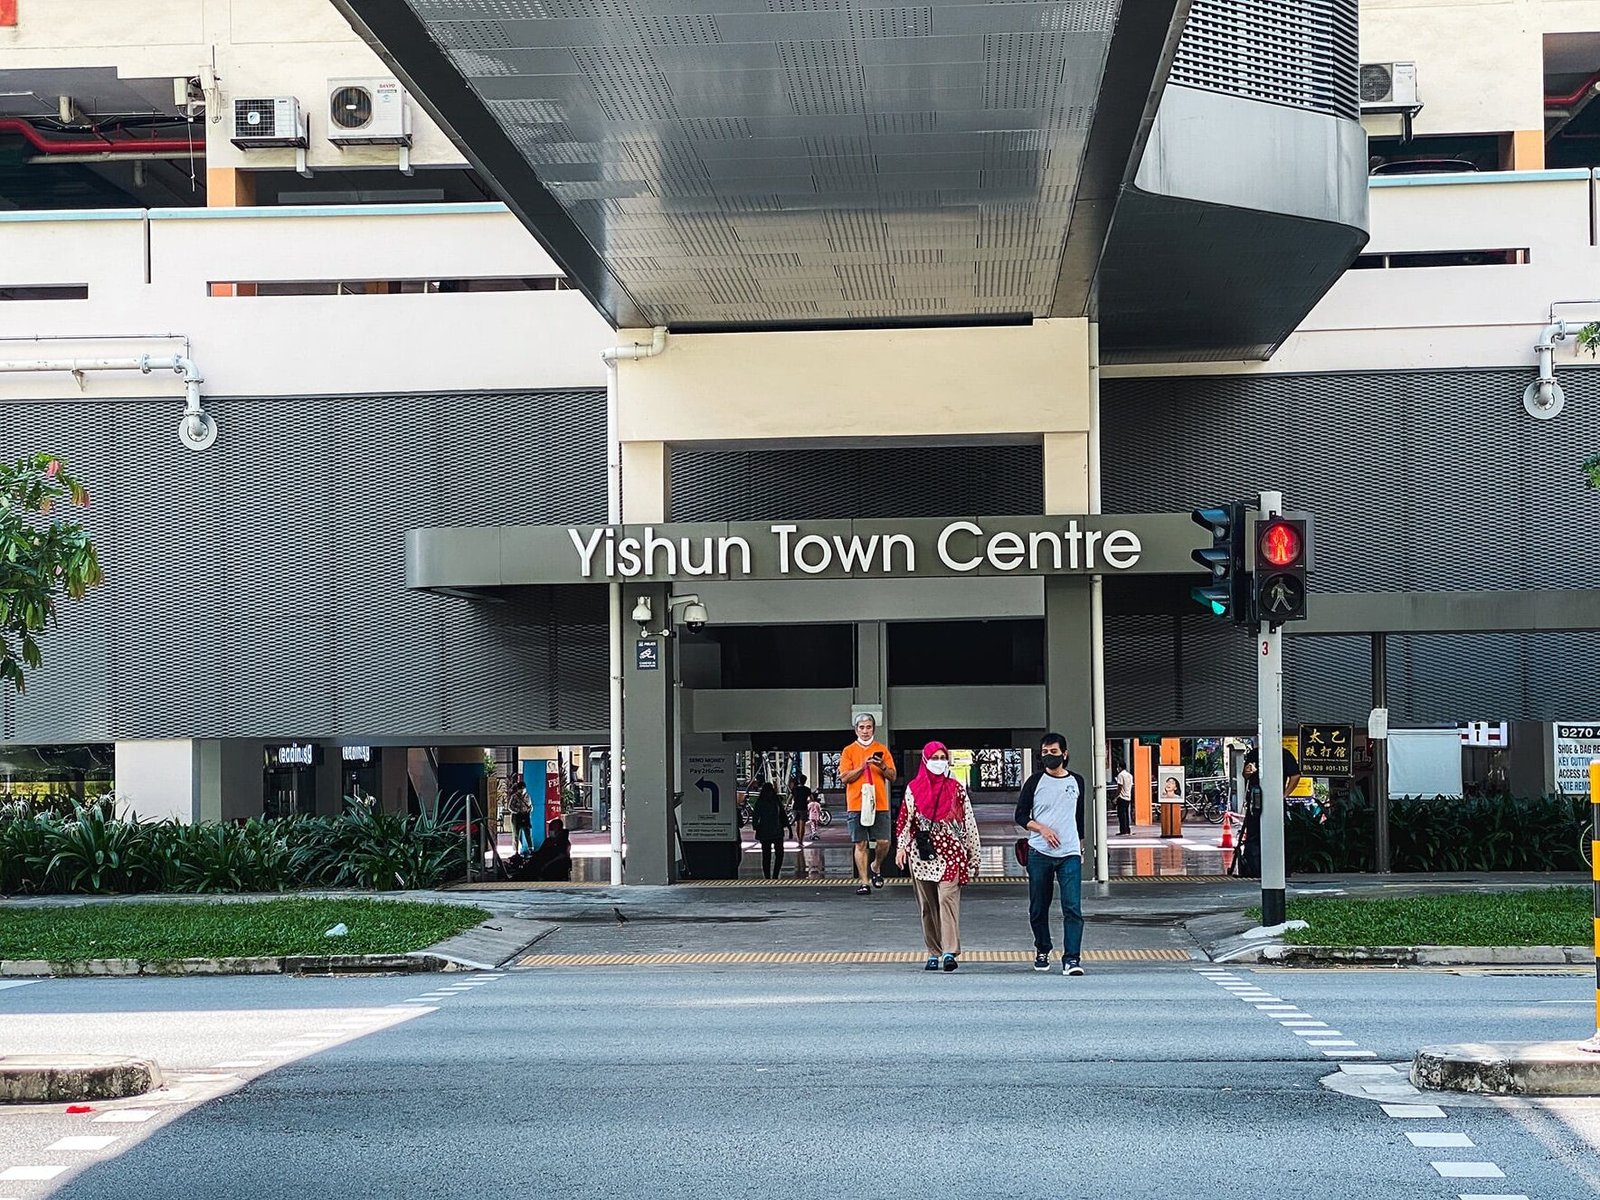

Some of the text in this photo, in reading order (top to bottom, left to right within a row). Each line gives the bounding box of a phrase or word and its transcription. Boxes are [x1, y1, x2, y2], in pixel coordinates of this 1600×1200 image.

[567, 520, 1142, 577] Yishun Town Centre
[1262, 641, 1269, 656] 3
[1561, 727, 1594, 738] 9270
[1557, 744, 1573, 754] SHOE
[1573, 744, 1579, 754] &
[1580, 744, 1592, 754] BAG
[1559, 757, 1593, 766] KEY CUTTIN
[1559, 769, 1590, 778] ACCESS CA
[1575, 781, 1591, 790] REMO
